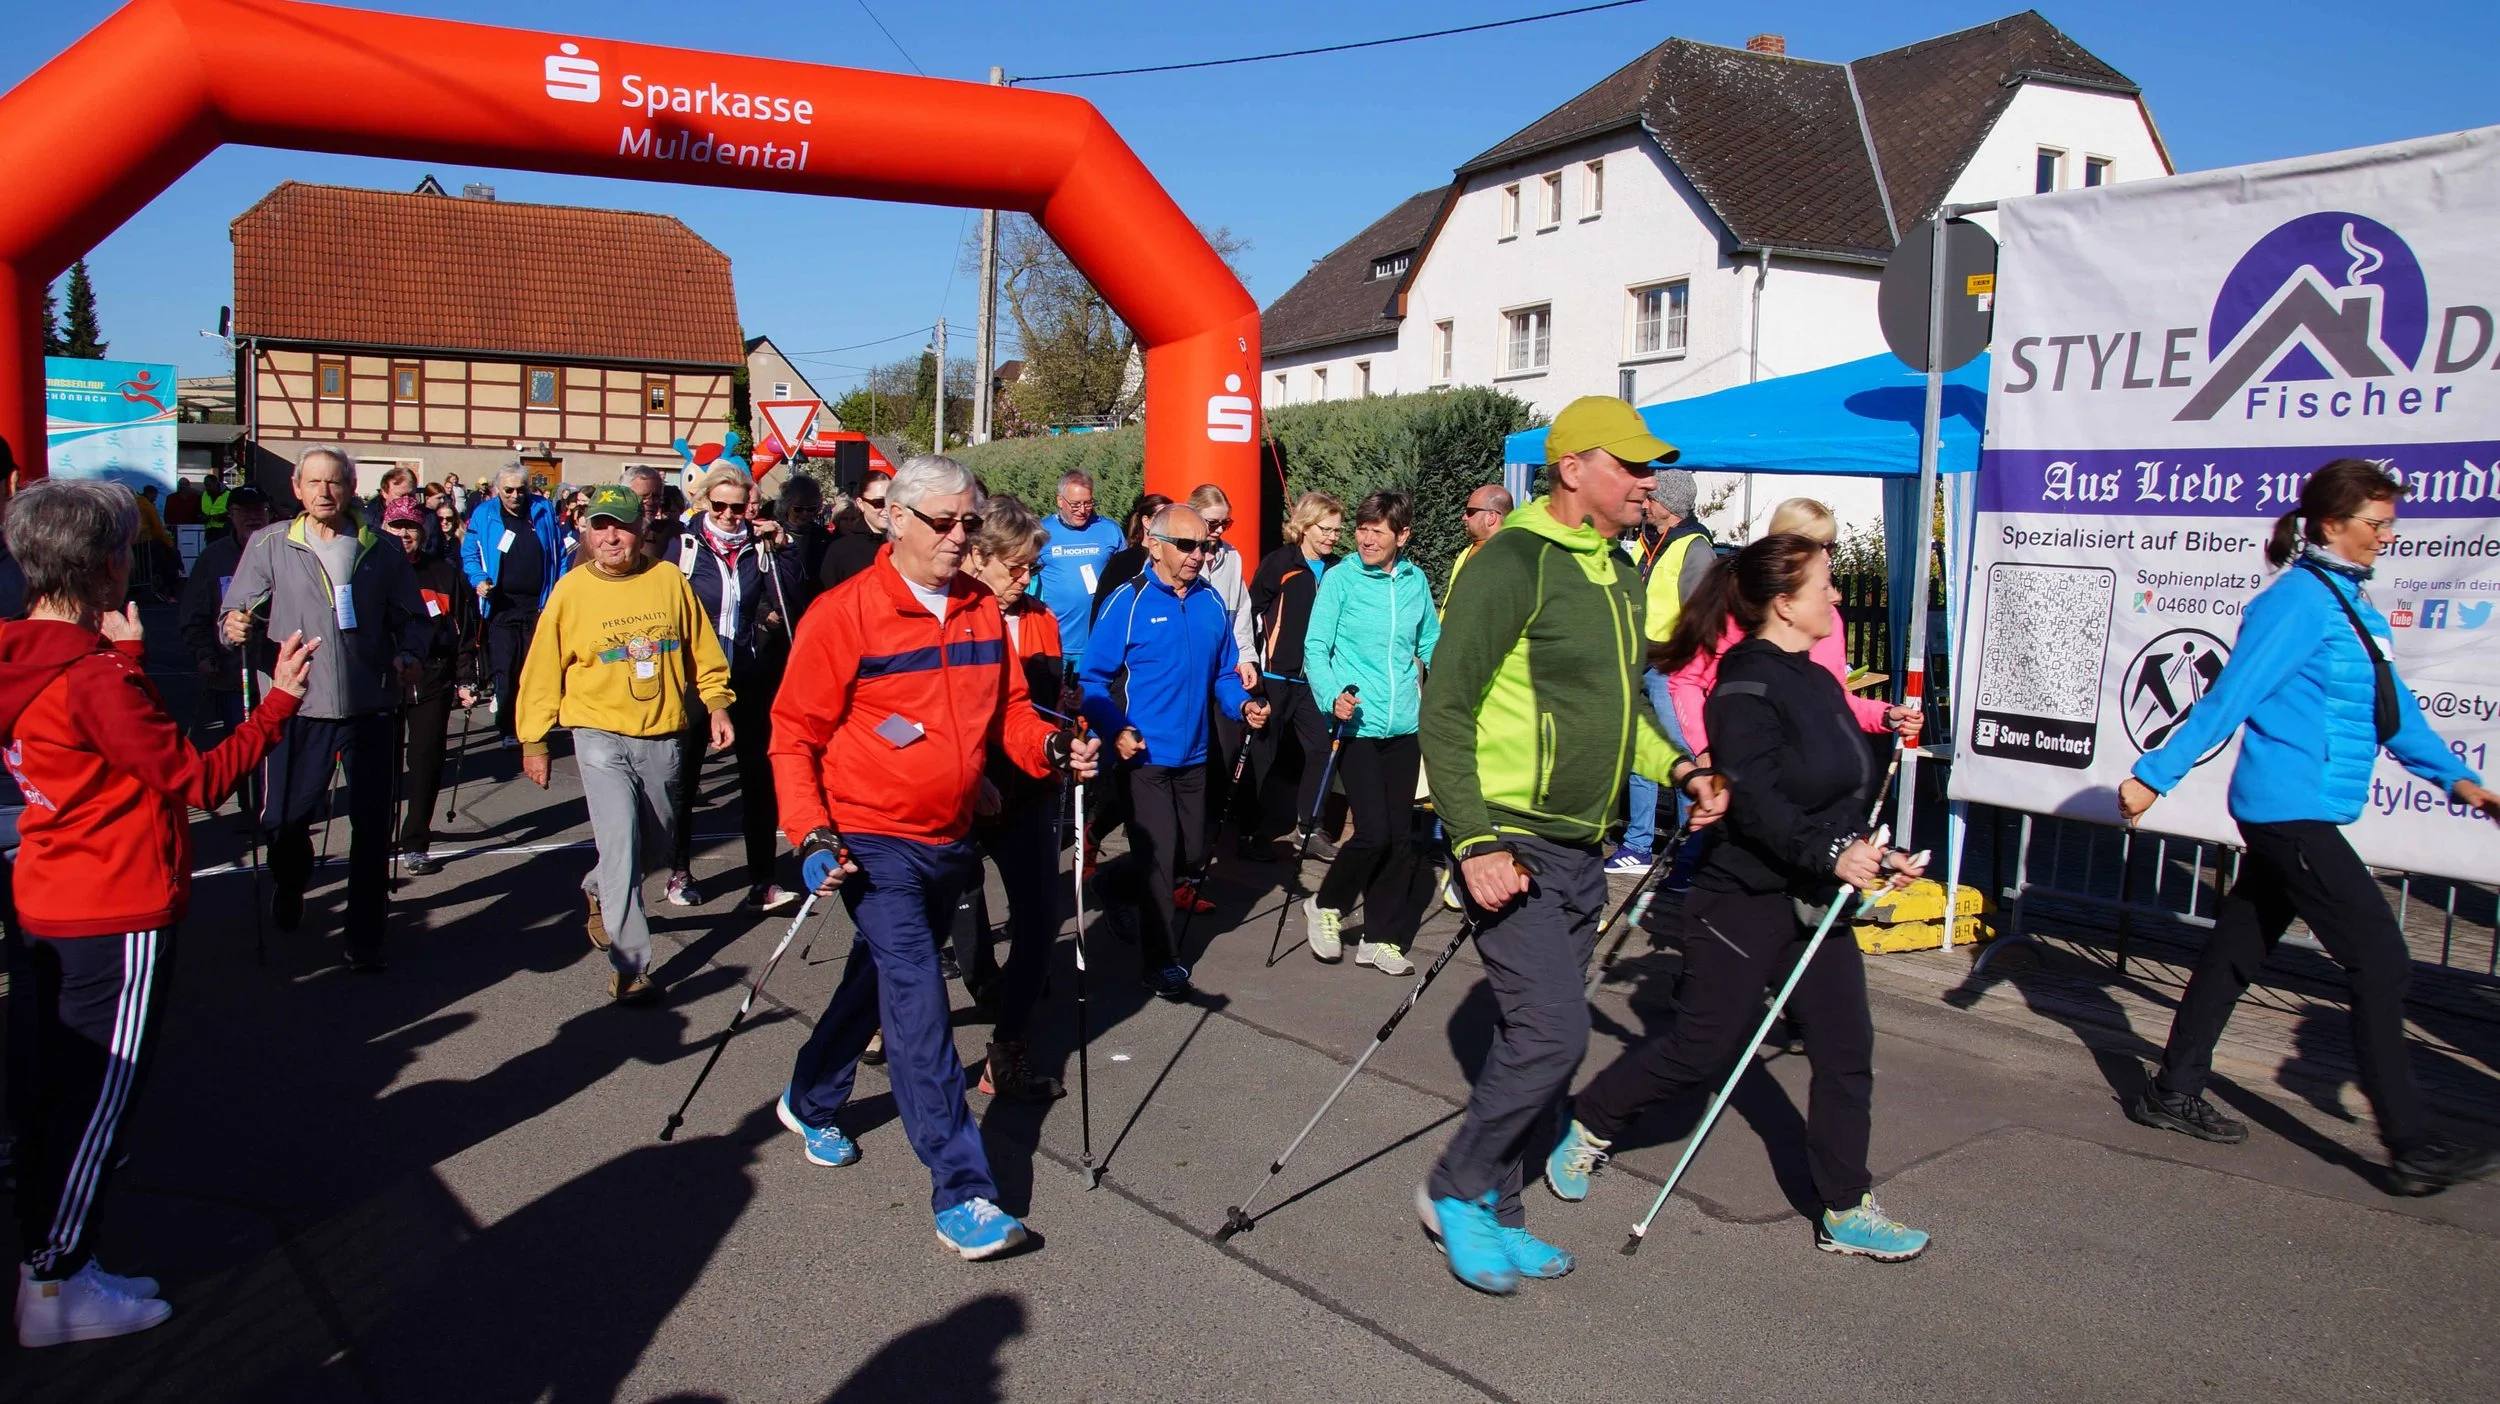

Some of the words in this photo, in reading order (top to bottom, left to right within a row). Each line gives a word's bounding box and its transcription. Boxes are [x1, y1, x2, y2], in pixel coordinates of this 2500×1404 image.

[621, 75, 814, 124] Sparkasse
[618, 126, 809, 171] Muldental
[2003, 327, 2199, 394] STYLE
[2433, 305, 2500, 374] D
[2246, 382, 2453, 420] Fischer
[2042, 461, 2122, 502] Aus
[2134, 461, 2245, 503] Liebe
[2255, 471, 2312, 511] zu
[1063, 547, 1100, 556] HOCHTIEF
[2002, 525, 2135, 549] Spezialisiert
[2140, 530, 2178, 550] auf
[2185, 531, 2256, 553] Biber-
[2136, 569, 2246, 591] Sophienplatz
[2250, 574, 2261, 589] 9
[2393, 578, 2427, 592] Folge
[2430, 581, 2453, 590] uns
[2454, 579, 2466, 590] in
[602, 611, 668, 629] PERSONALITY
[2156, 596, 2207, 614] 04680
[2409, 689, 2500, 721] o@sty
[1999, 725, 2030, 747] Save
[2035, 730, 2092, 756] Contact
